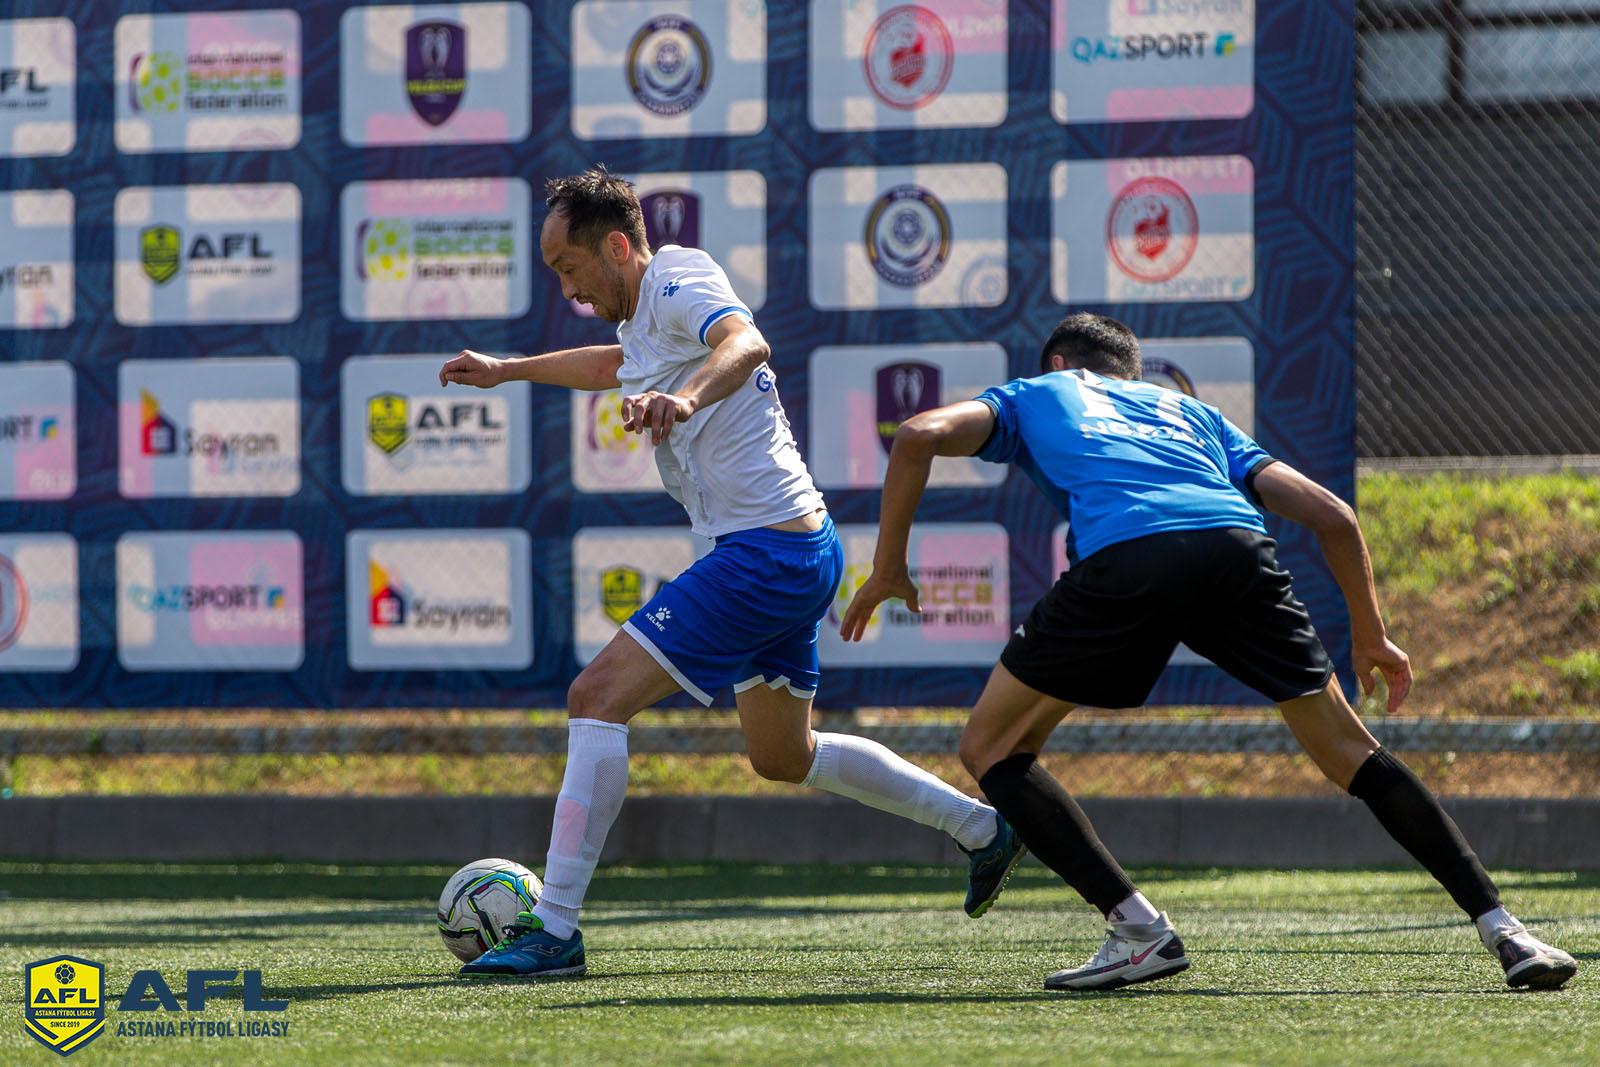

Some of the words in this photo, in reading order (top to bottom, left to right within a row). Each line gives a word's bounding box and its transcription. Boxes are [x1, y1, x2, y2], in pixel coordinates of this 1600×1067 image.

[1070, 32, 1208, 65] QAZSPORT
[189, 233, 273, 258] AFL
[417, 404, 503, 428] AFL
[645, 612, 666, 632] KELME
